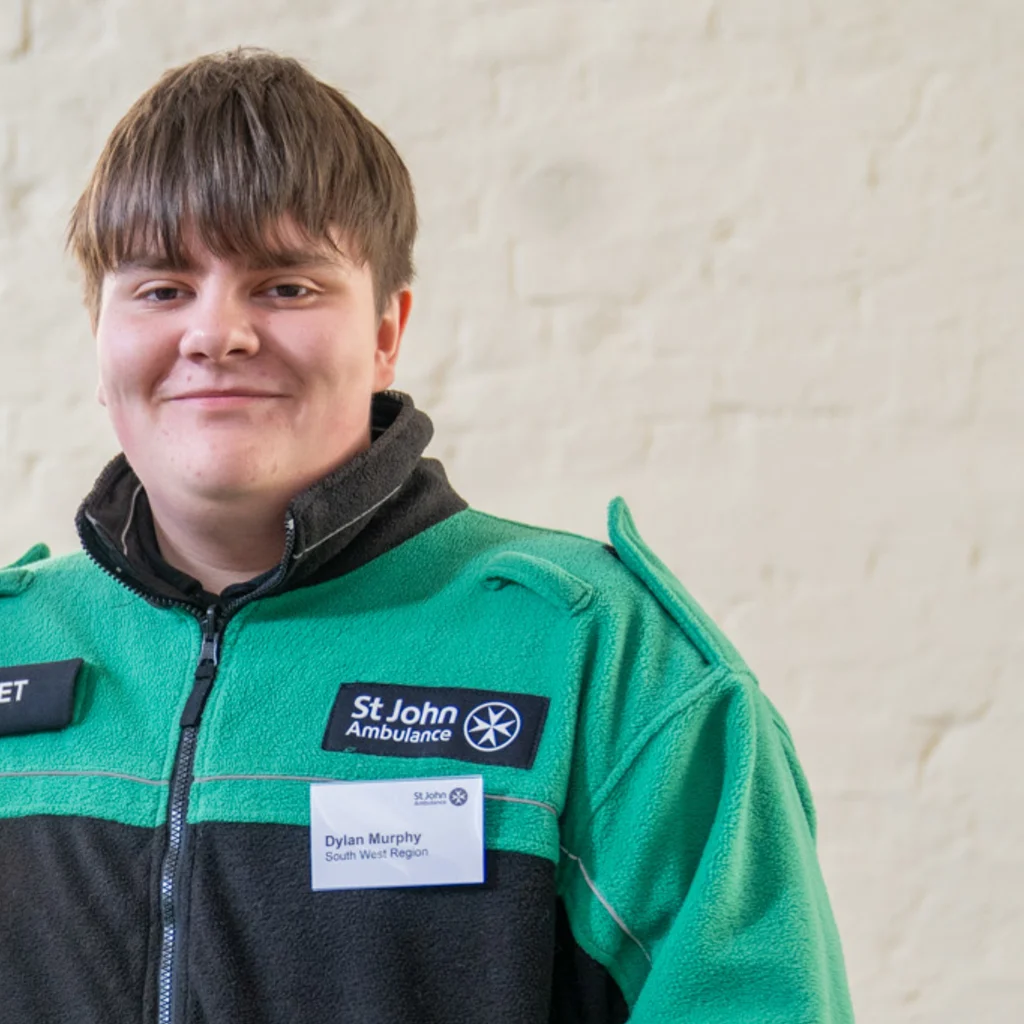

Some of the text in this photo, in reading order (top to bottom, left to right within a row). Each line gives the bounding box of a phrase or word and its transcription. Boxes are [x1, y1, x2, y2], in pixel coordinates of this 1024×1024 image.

[350, 695, 458, 725] St John
[345, 721, 452, 743] Ambulance
[413, 790, 447, 800] St John
[325, 831, 422, 849] Dylan Murphy
[325, 847, 429, 862] South West Region
